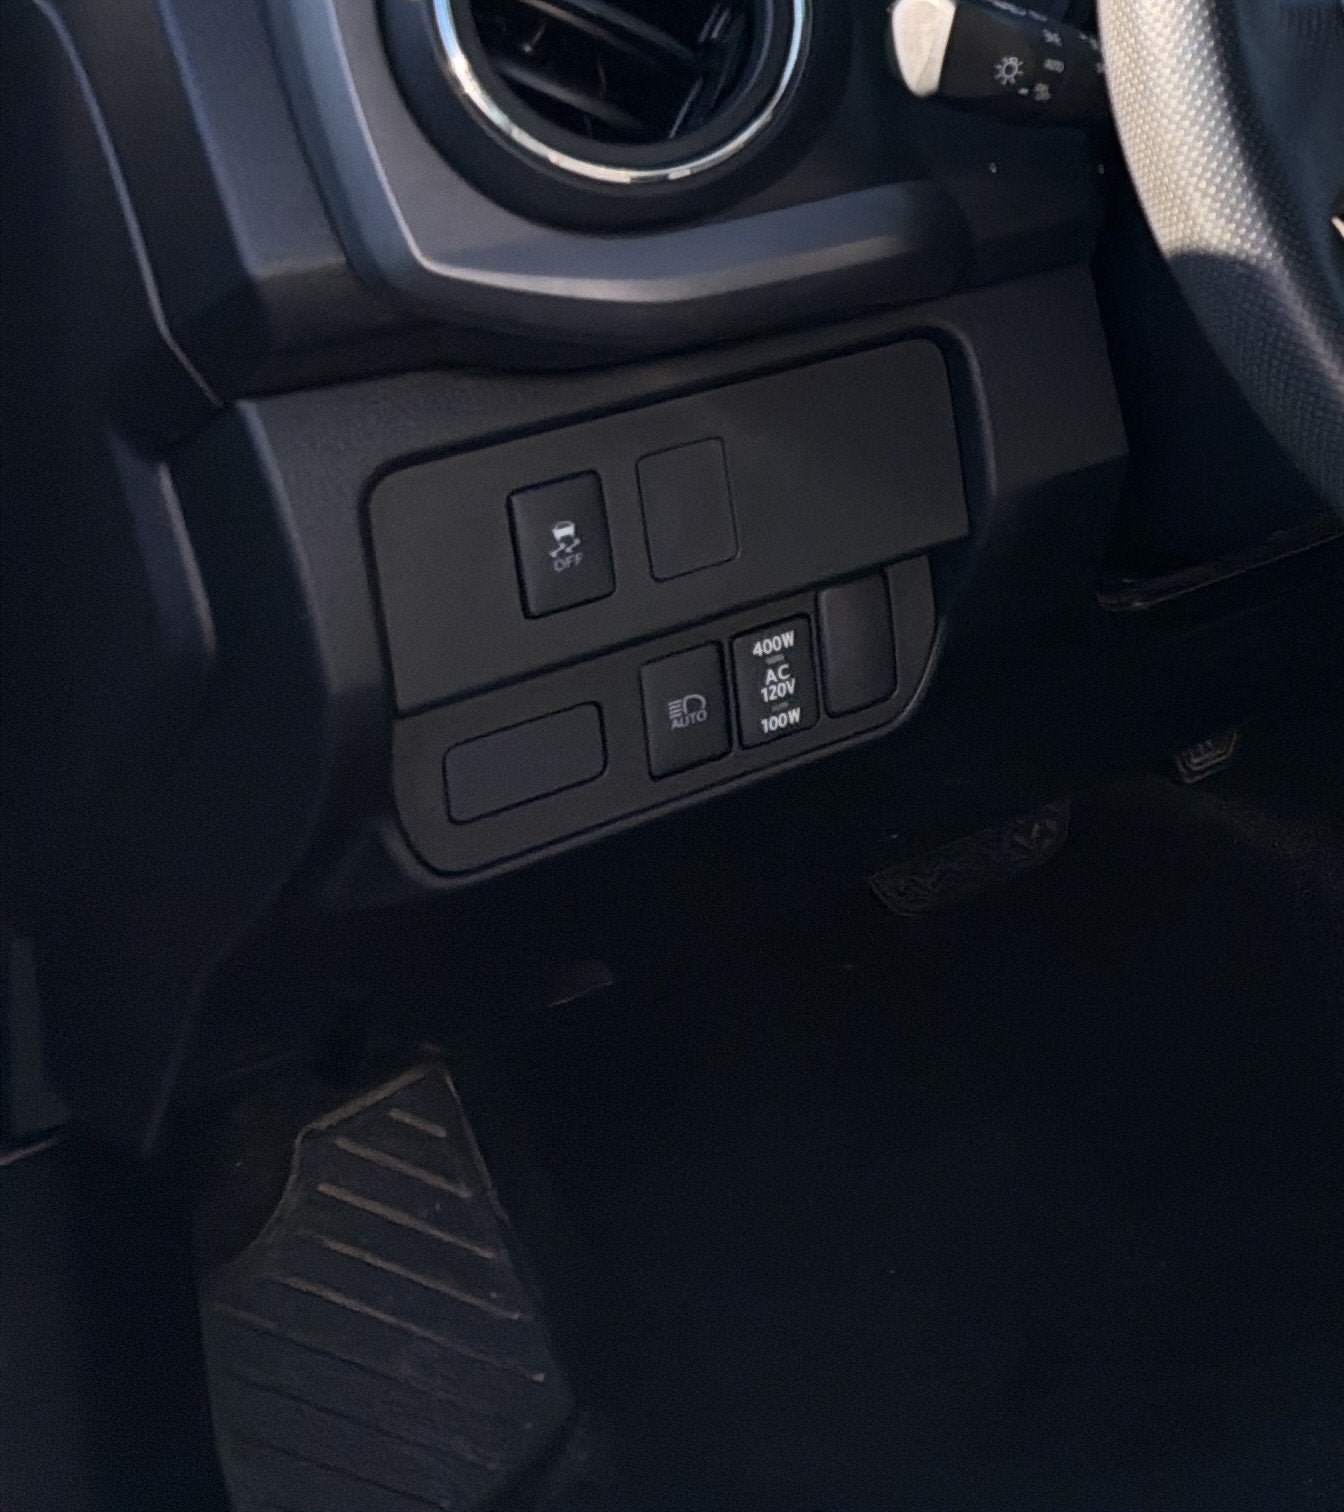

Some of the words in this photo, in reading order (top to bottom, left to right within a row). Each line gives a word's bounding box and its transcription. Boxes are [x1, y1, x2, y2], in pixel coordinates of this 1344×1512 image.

[553, 551, 584, 573] OFF
[752, 629, 795, 657] 400W
[765, 663, 791, 686] AC
[760, 678, 796, 703] 120V
[671, 709, 708, 730] AUTO
[760, 706, 801, 734] 100W
